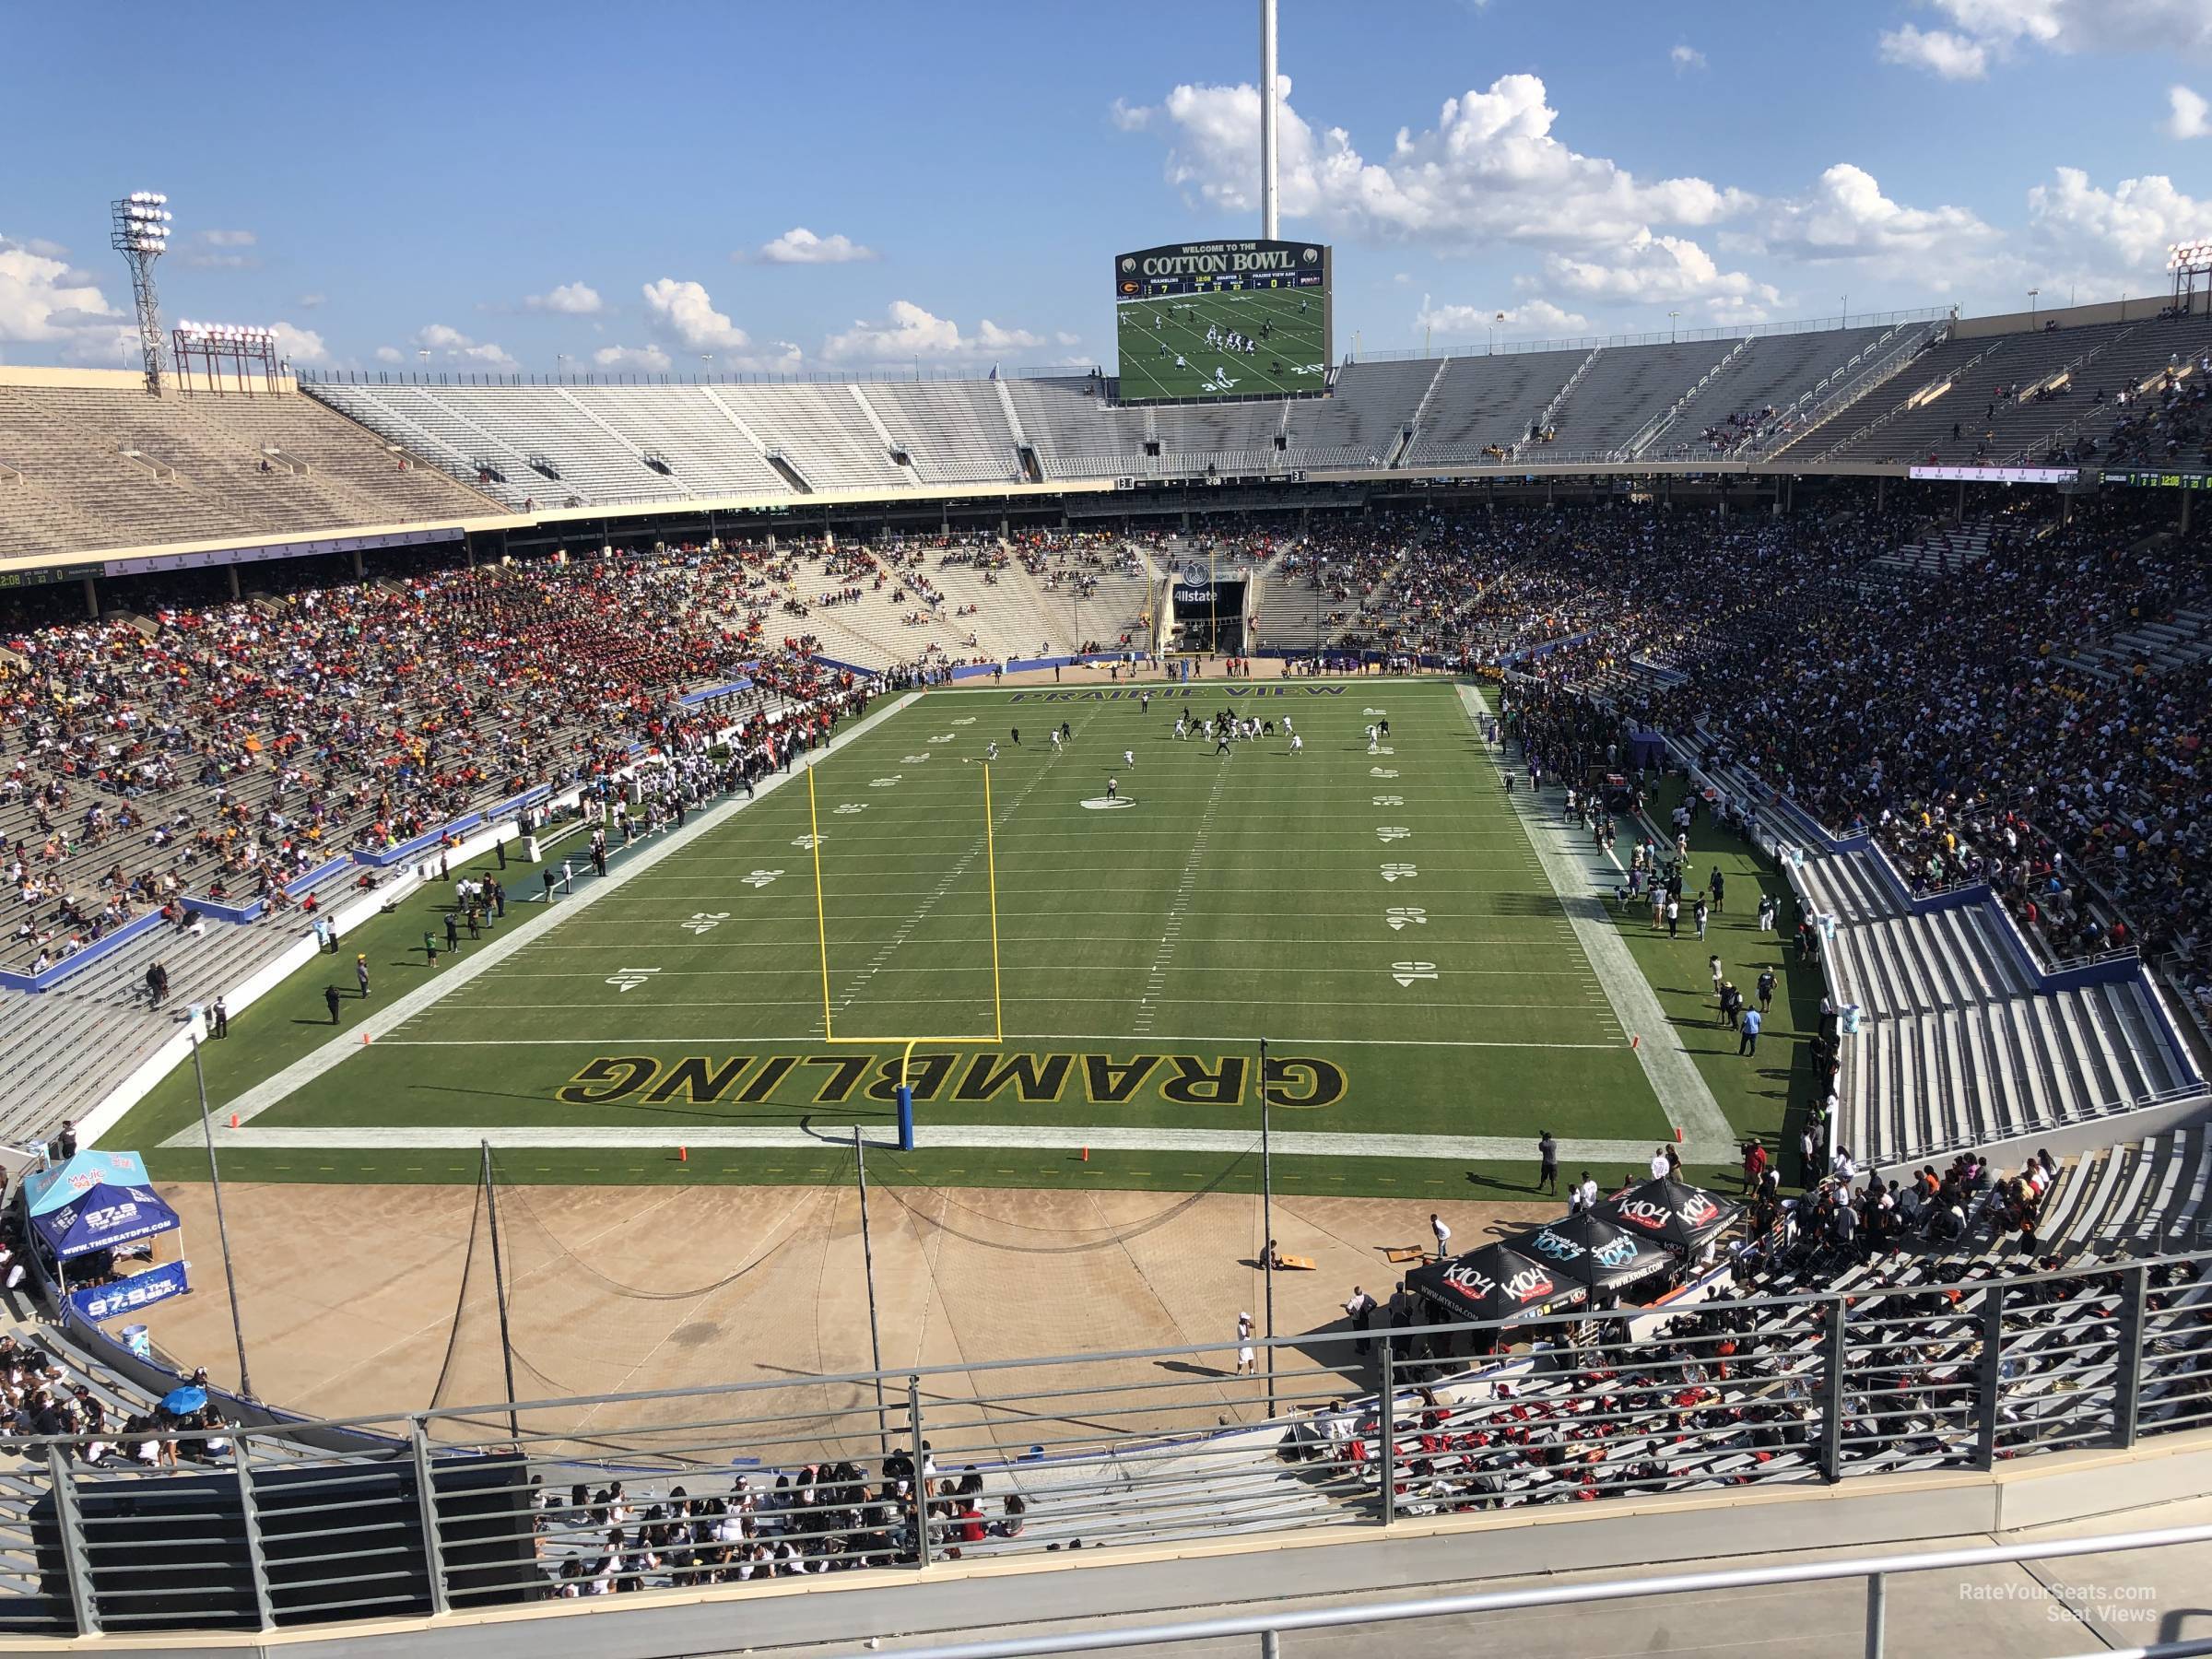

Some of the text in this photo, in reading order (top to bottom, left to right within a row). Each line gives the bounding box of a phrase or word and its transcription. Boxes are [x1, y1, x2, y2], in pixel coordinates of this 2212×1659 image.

[1182, 244, 1224, 254] WELCOME
[1240, 242, 1256, 251] THE
[1143, 250, 1296, 276] COTTON BOWL
[1161, 285, 1168, 293] 7
[1271, 279, 1277, 288] 0
[2130, 474, 2136, 484] 7
[2150, 478, 2157, 487] 12
[2161, 475, 2180, 487] 12:08
[2191, 480, 2198, 488] 23
[0, 574, 20, 586] 2:08
[56, 570, 63, 580] 0
[1174, 590, 1218, 602] Allstate
[1007, 685, 1350, 702] PRAIRIE VIEW
[741, 868, 785, 884] 30
[1380, 863, 1418, 877] 30
[680, 912, 731, 930] 20
[1385, 907, 1428, 924] 20
[605, 967, 663, 984] 10
[1391, 961, 1439, 980] 10
[555, 1053, 1348, 1108] GRAMBLING
[85, 1203, 137, 1224] 97.9
[1618, 1199, 1672, 1225] K104
[1676, 1194, 1712, 1226] K104
[1543, 1229, 1571, 1247] Smooth
[1532, 1235, 1581, 1262] 105.7
[1591, 1236, 1618, 1258] Smooth
[1442, 1263, 1496, 1296] K104
[1500, 1267, 1550, 1300] K104
[1607, 1262, 1664, 1290] WWW.KRNB.COM
[147, 1279, 171, 1292] THE
[147, 1284, 178, 1300] BEAT
[88, 1288, 147, 1316] 97.9
[1420, 1285, 1478, 1322] WWW.MYK104.COM
[1570, 1288, 1586, 1303] K104
